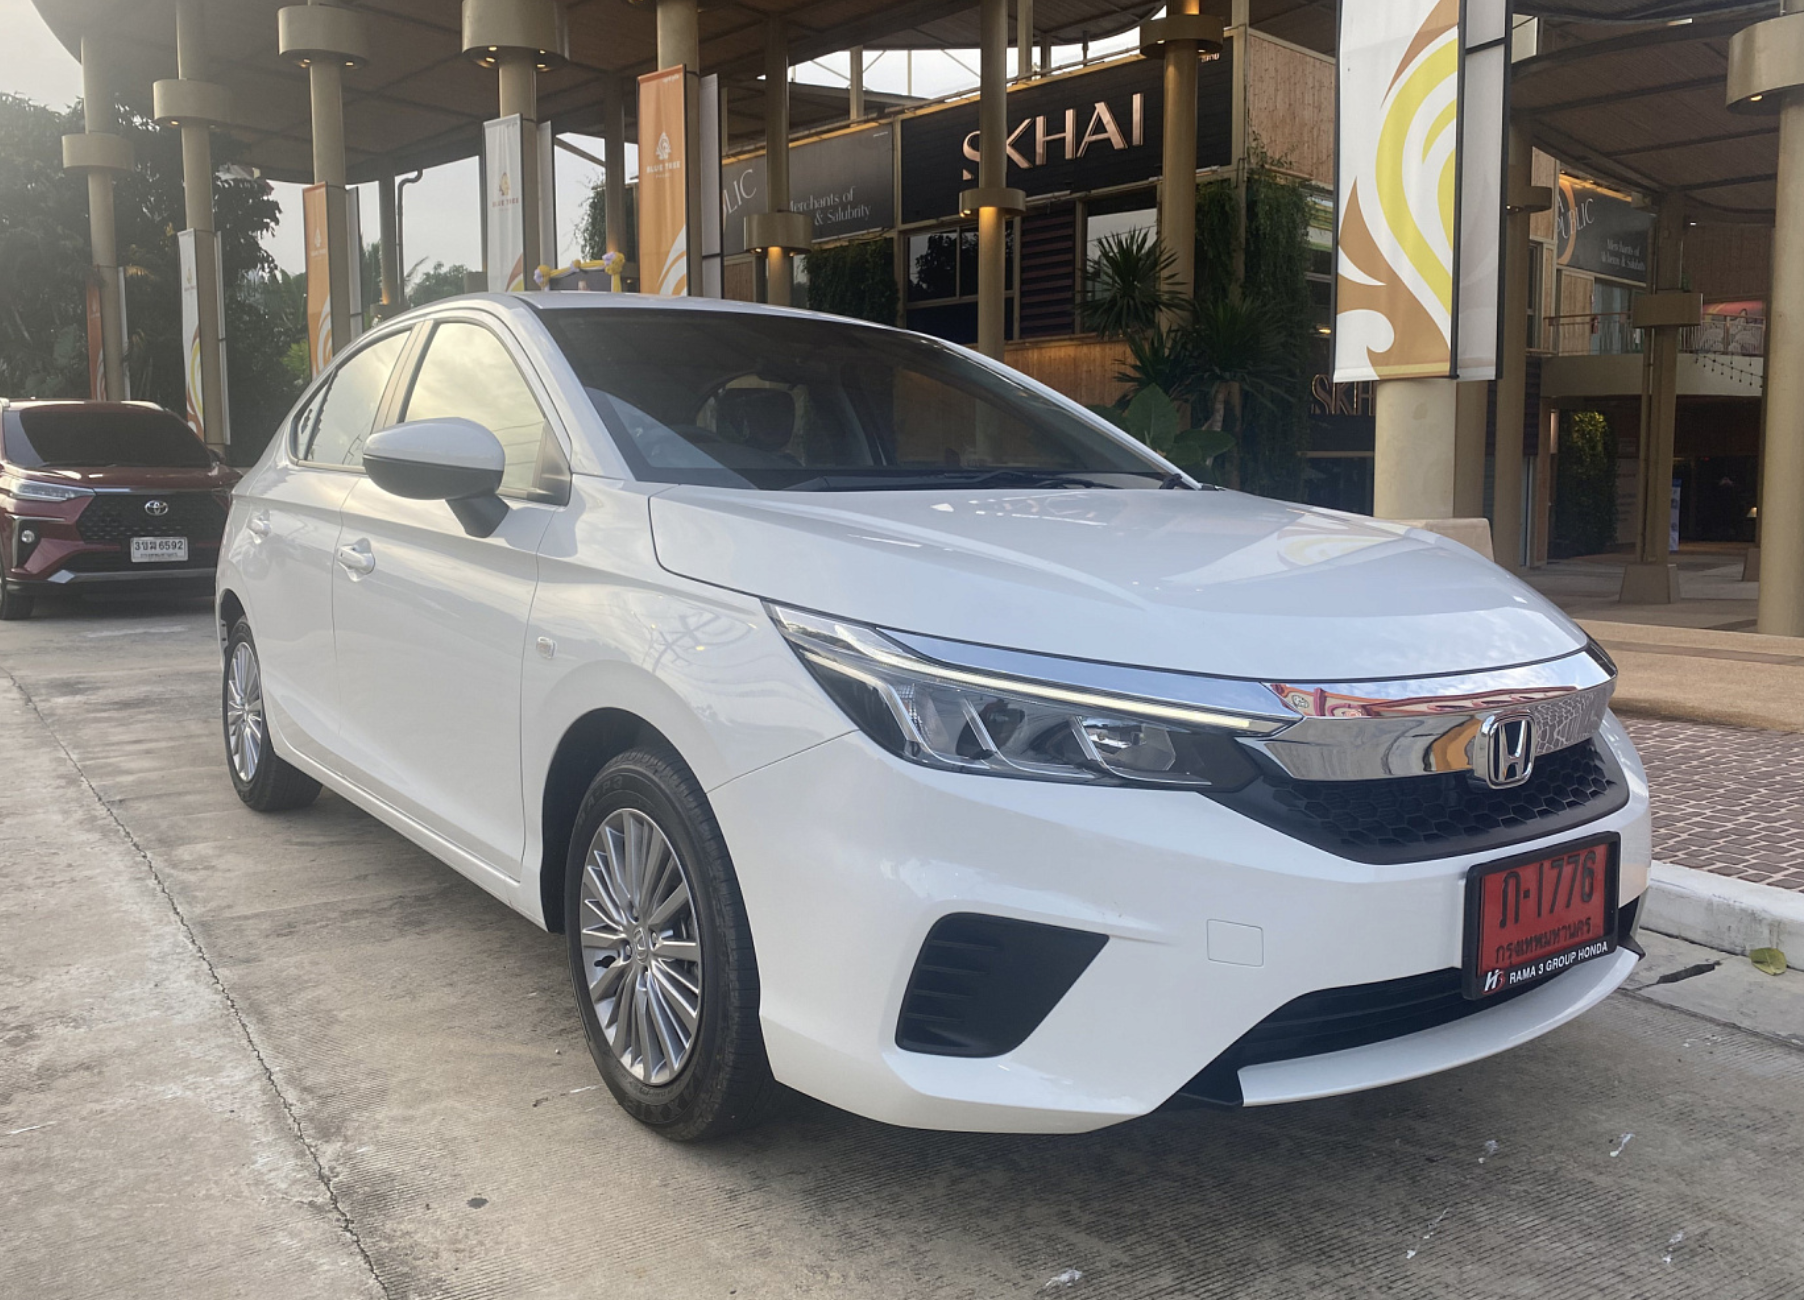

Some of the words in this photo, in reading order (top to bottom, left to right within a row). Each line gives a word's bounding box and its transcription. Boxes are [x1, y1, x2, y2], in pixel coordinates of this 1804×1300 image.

[962, 92, 1145, 181] SKHAI
[723, 169, 757, 214] LIC
[842, 186, 856, 202] of
[814, 210, 824, 226] &
[827, 204, 871, 224] Salubrity
[1311, 373, 1377, 416] SKH
[158, 540, 184, 551] 6592
[1509, 965, 1536, 985] RAMA
[1538, 963, 1544, 975] 3
[1545, 951, 1577, 972] GROUP
[1578, 941, 1608, 961] HONDA
